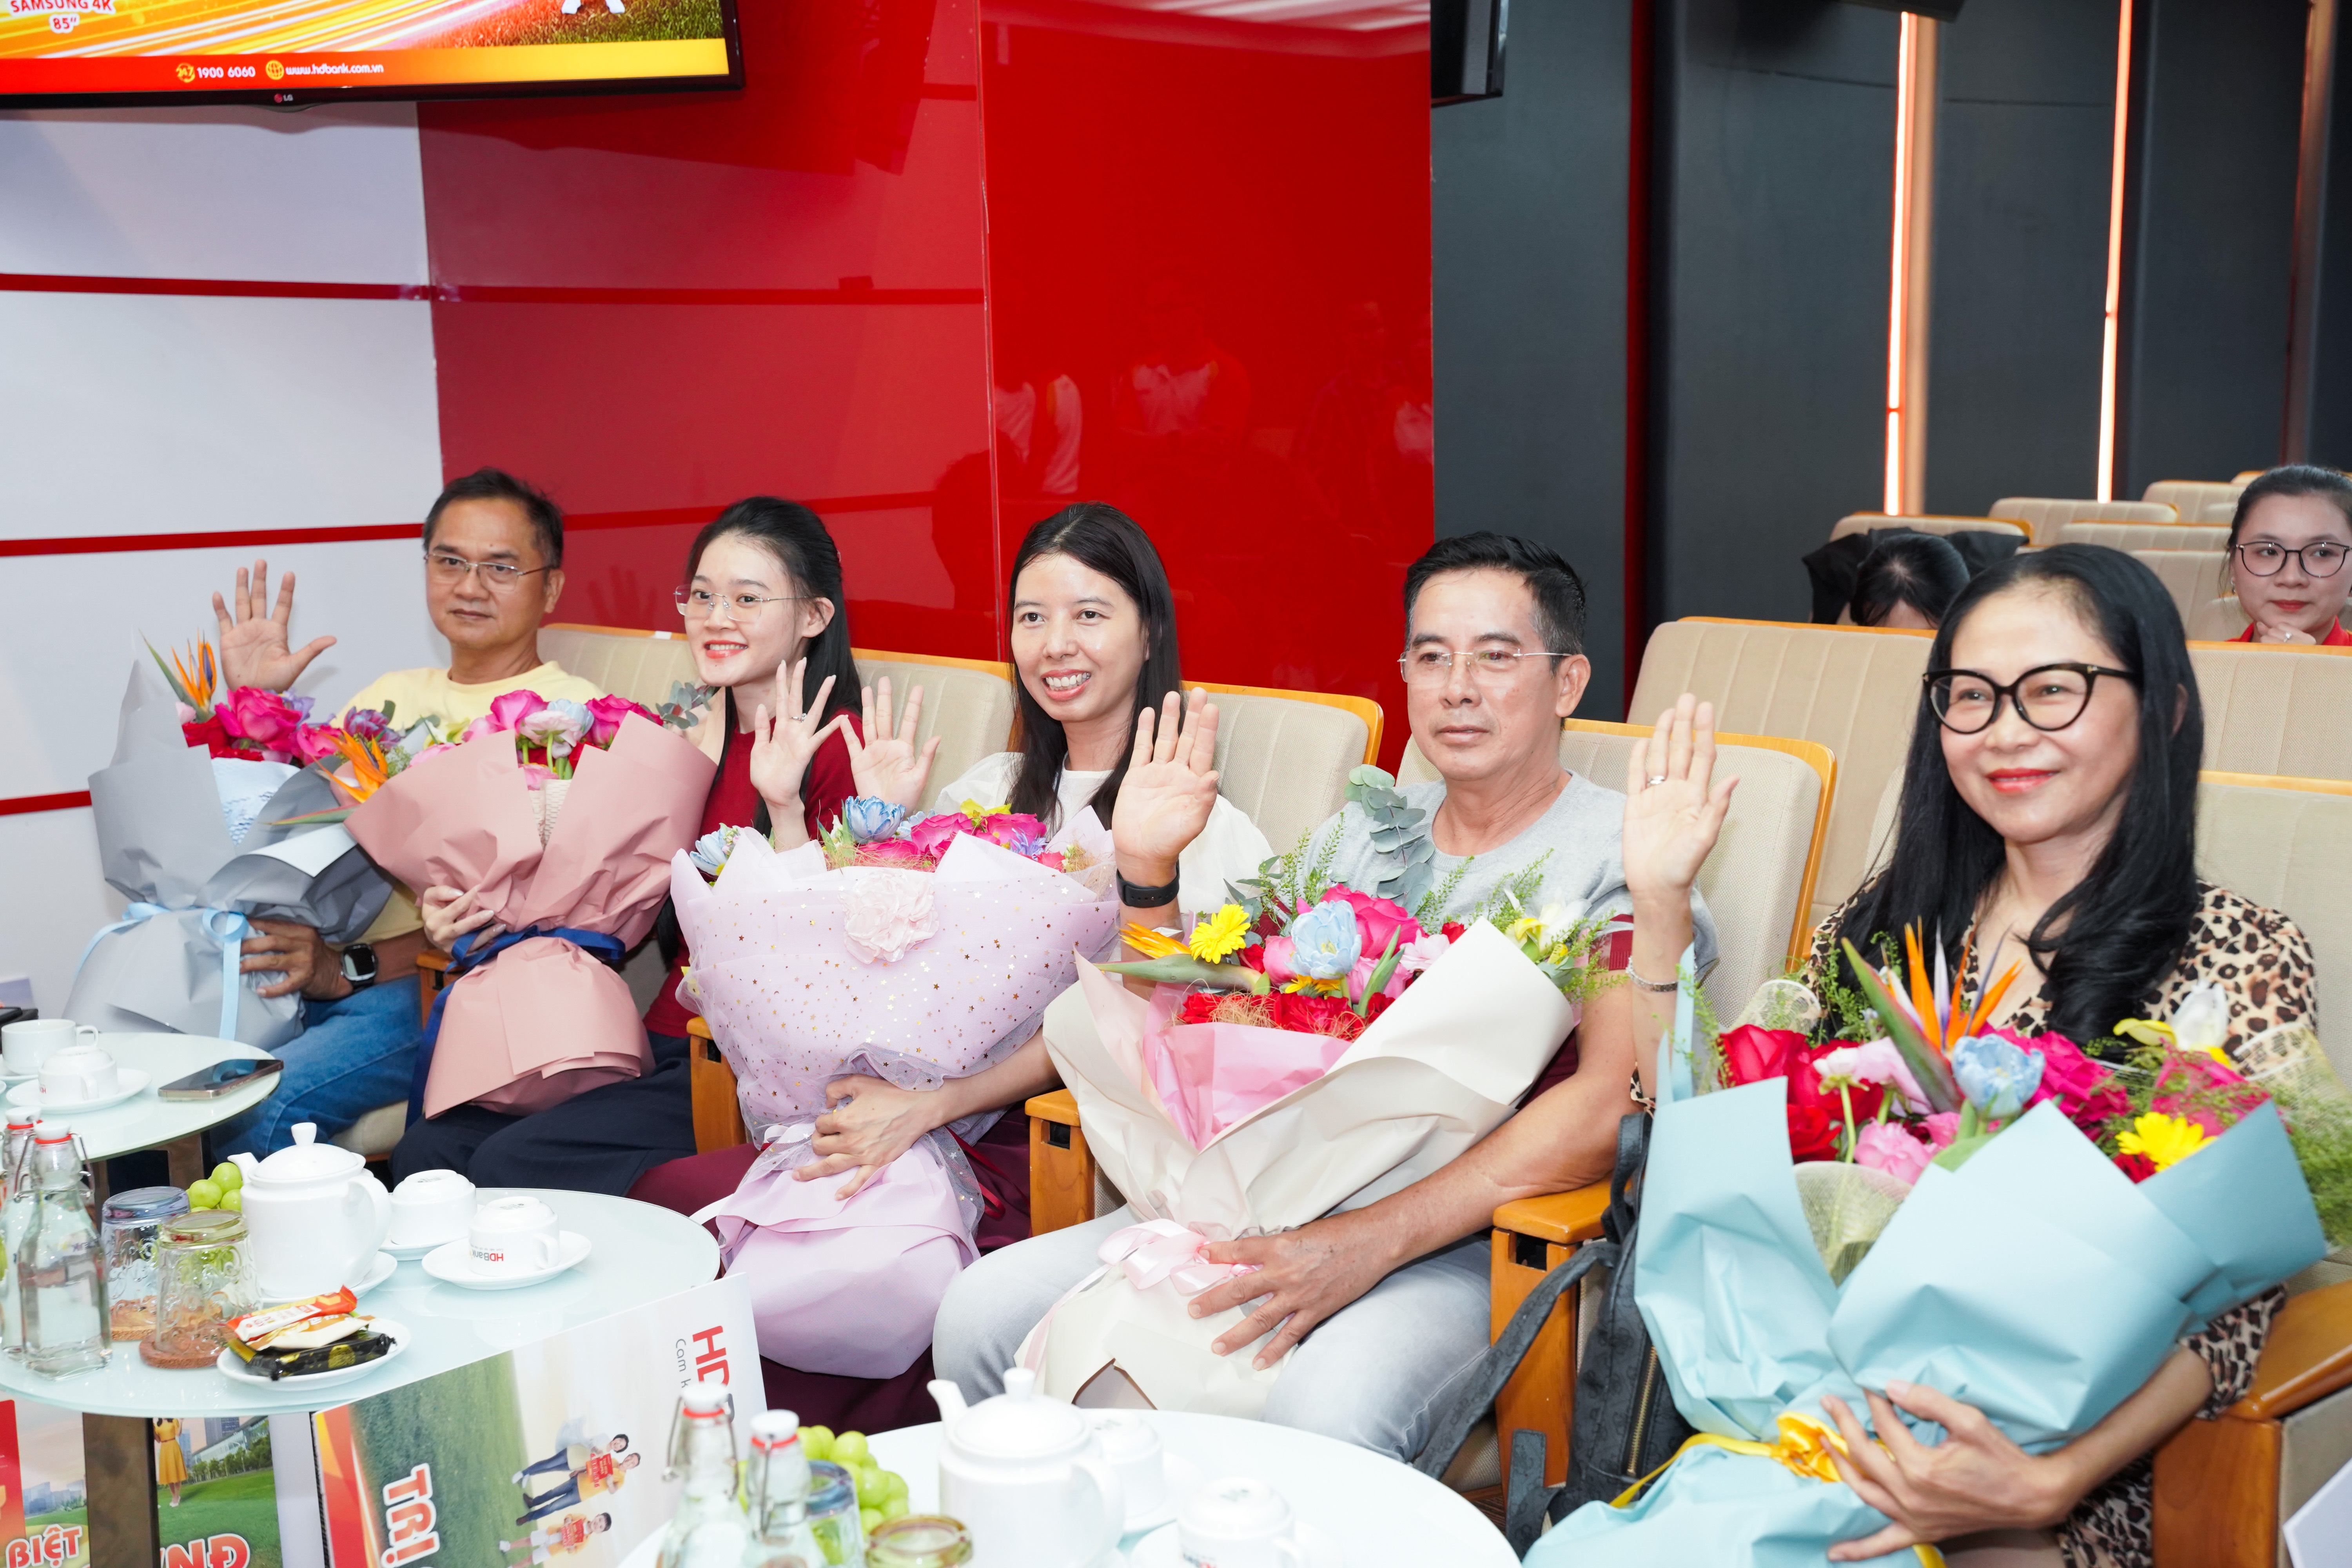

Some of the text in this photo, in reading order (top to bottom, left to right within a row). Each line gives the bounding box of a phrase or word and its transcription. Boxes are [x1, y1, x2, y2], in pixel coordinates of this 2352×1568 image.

[10, 0, 112, 13] SAMSUNG 4K
[197, 66, 224, 78] 1900
[227, 66, 256, 78] 6060
[285, 62, 384, 75] www.hdbank.com.vn
[472, 1249, 504, 1261] HDBank
[675, 1338, 686, 1372] Cam
[384, 1465, 437, 1567] TRỊ
[7, 1525, 81, 1568] BIỆT
[160, 1534, 250, 1568] NĐ
